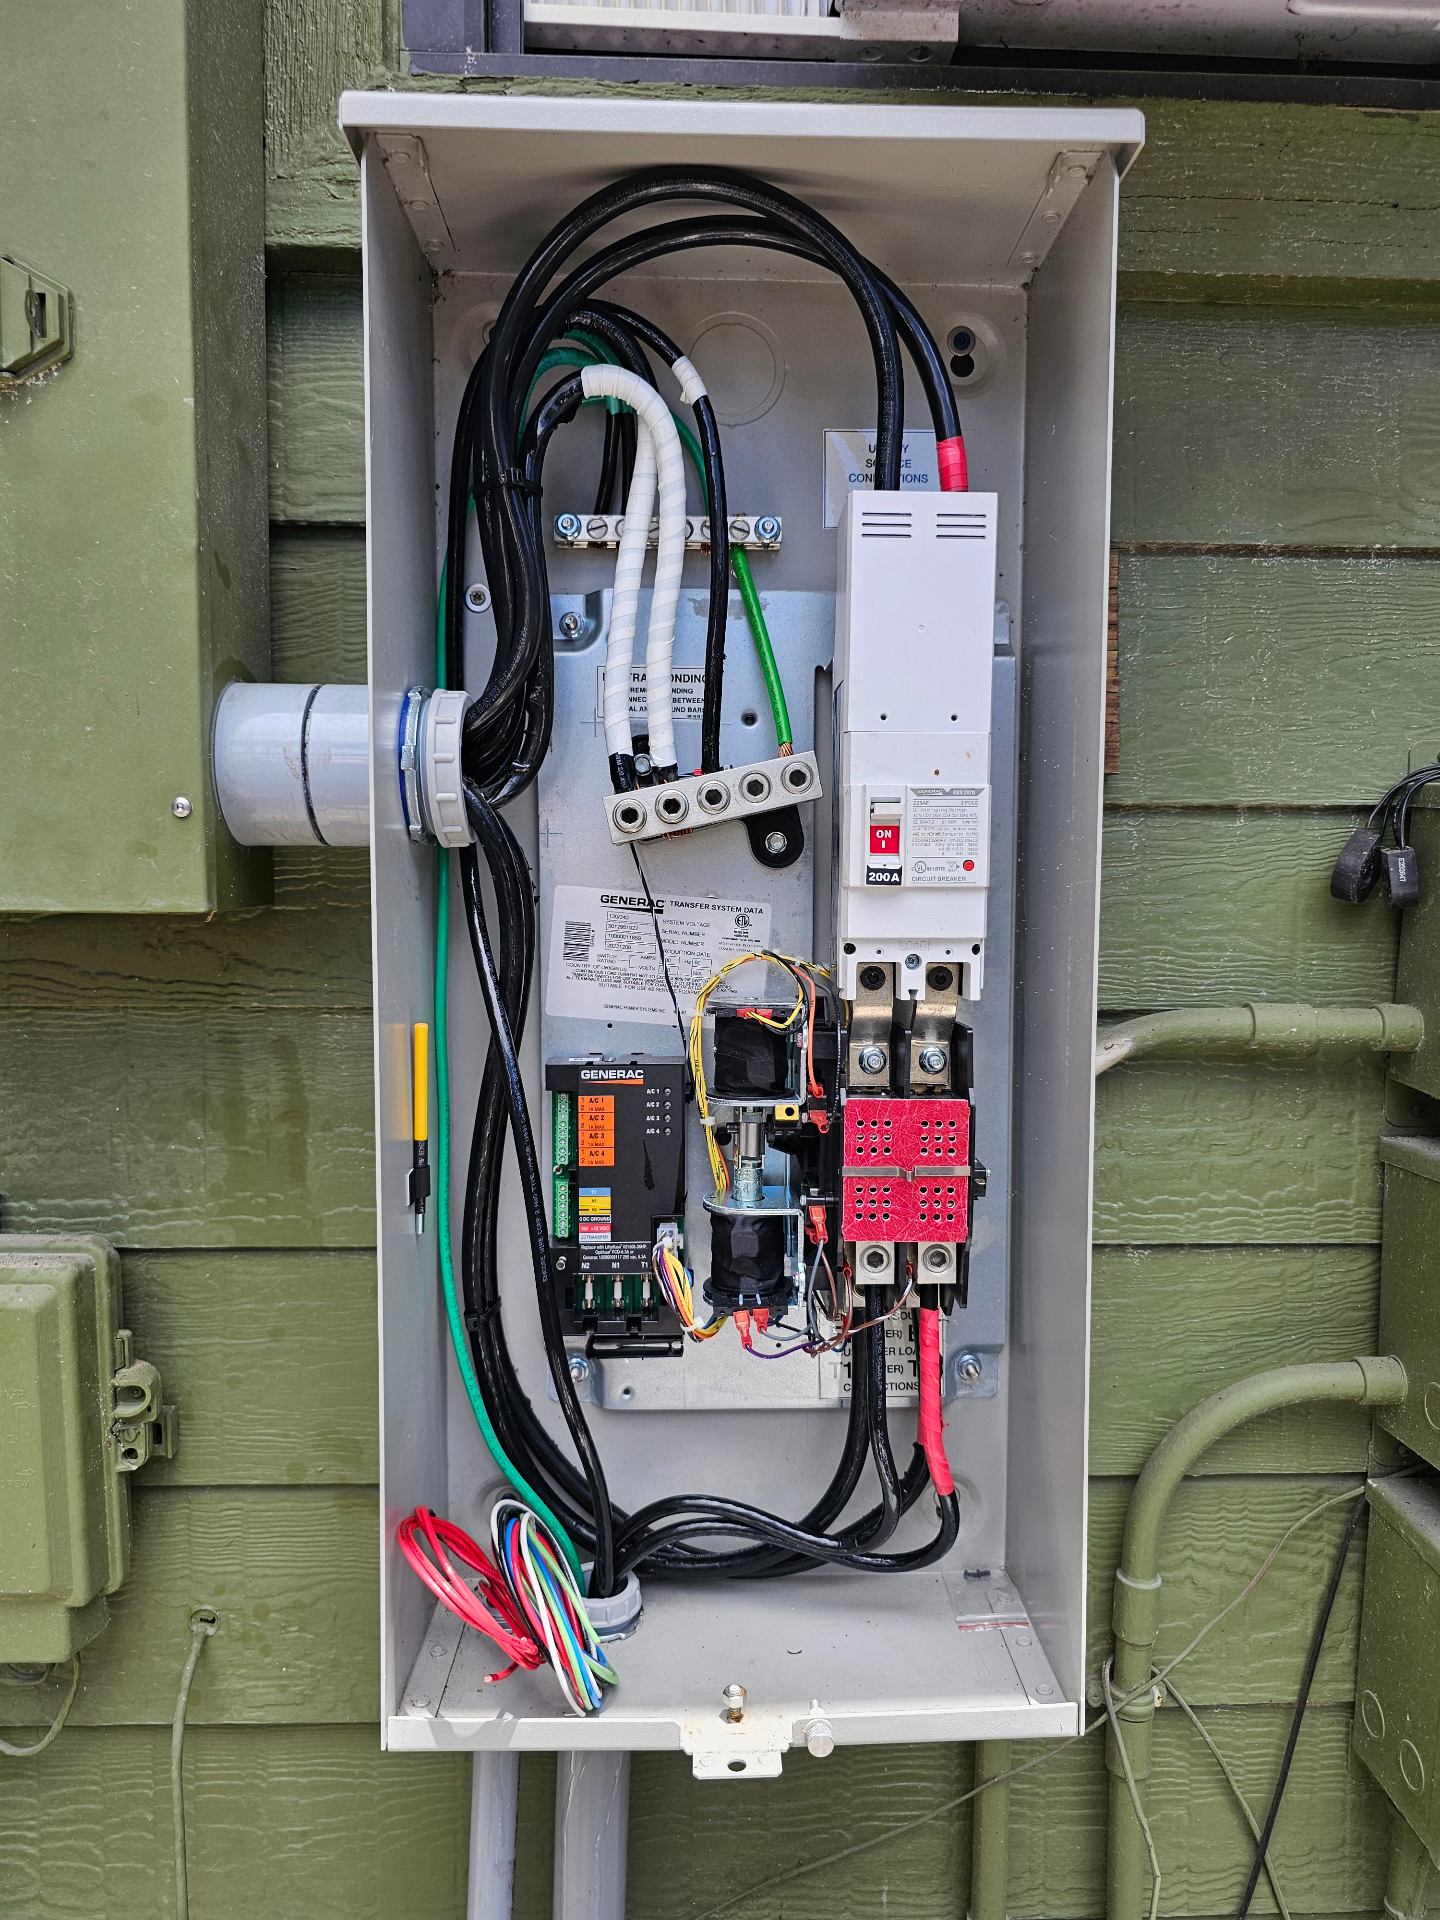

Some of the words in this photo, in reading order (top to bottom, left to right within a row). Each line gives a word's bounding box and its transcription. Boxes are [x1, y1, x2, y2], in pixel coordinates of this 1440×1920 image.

[866, 459, 911, 468] SCE
[849, 474, 928, 483] CONIONS
[671, 673, 705, 683] NDIN
[875, 829, 892, 838] ON
[600, 894, 665, 908] GENERAC
[670, 900, 710, 910] TRANSFER
[711, 904, 742, 913] SYSTEM
[581, 1070, 644, 1079] GENERAC
[581, 1261, 590, 1269] N2
[612, 1261, 620, 1269] N1
[899, 1347, 916, 1356] LOA
[843, 1382, 919, 1391] CTIONS
